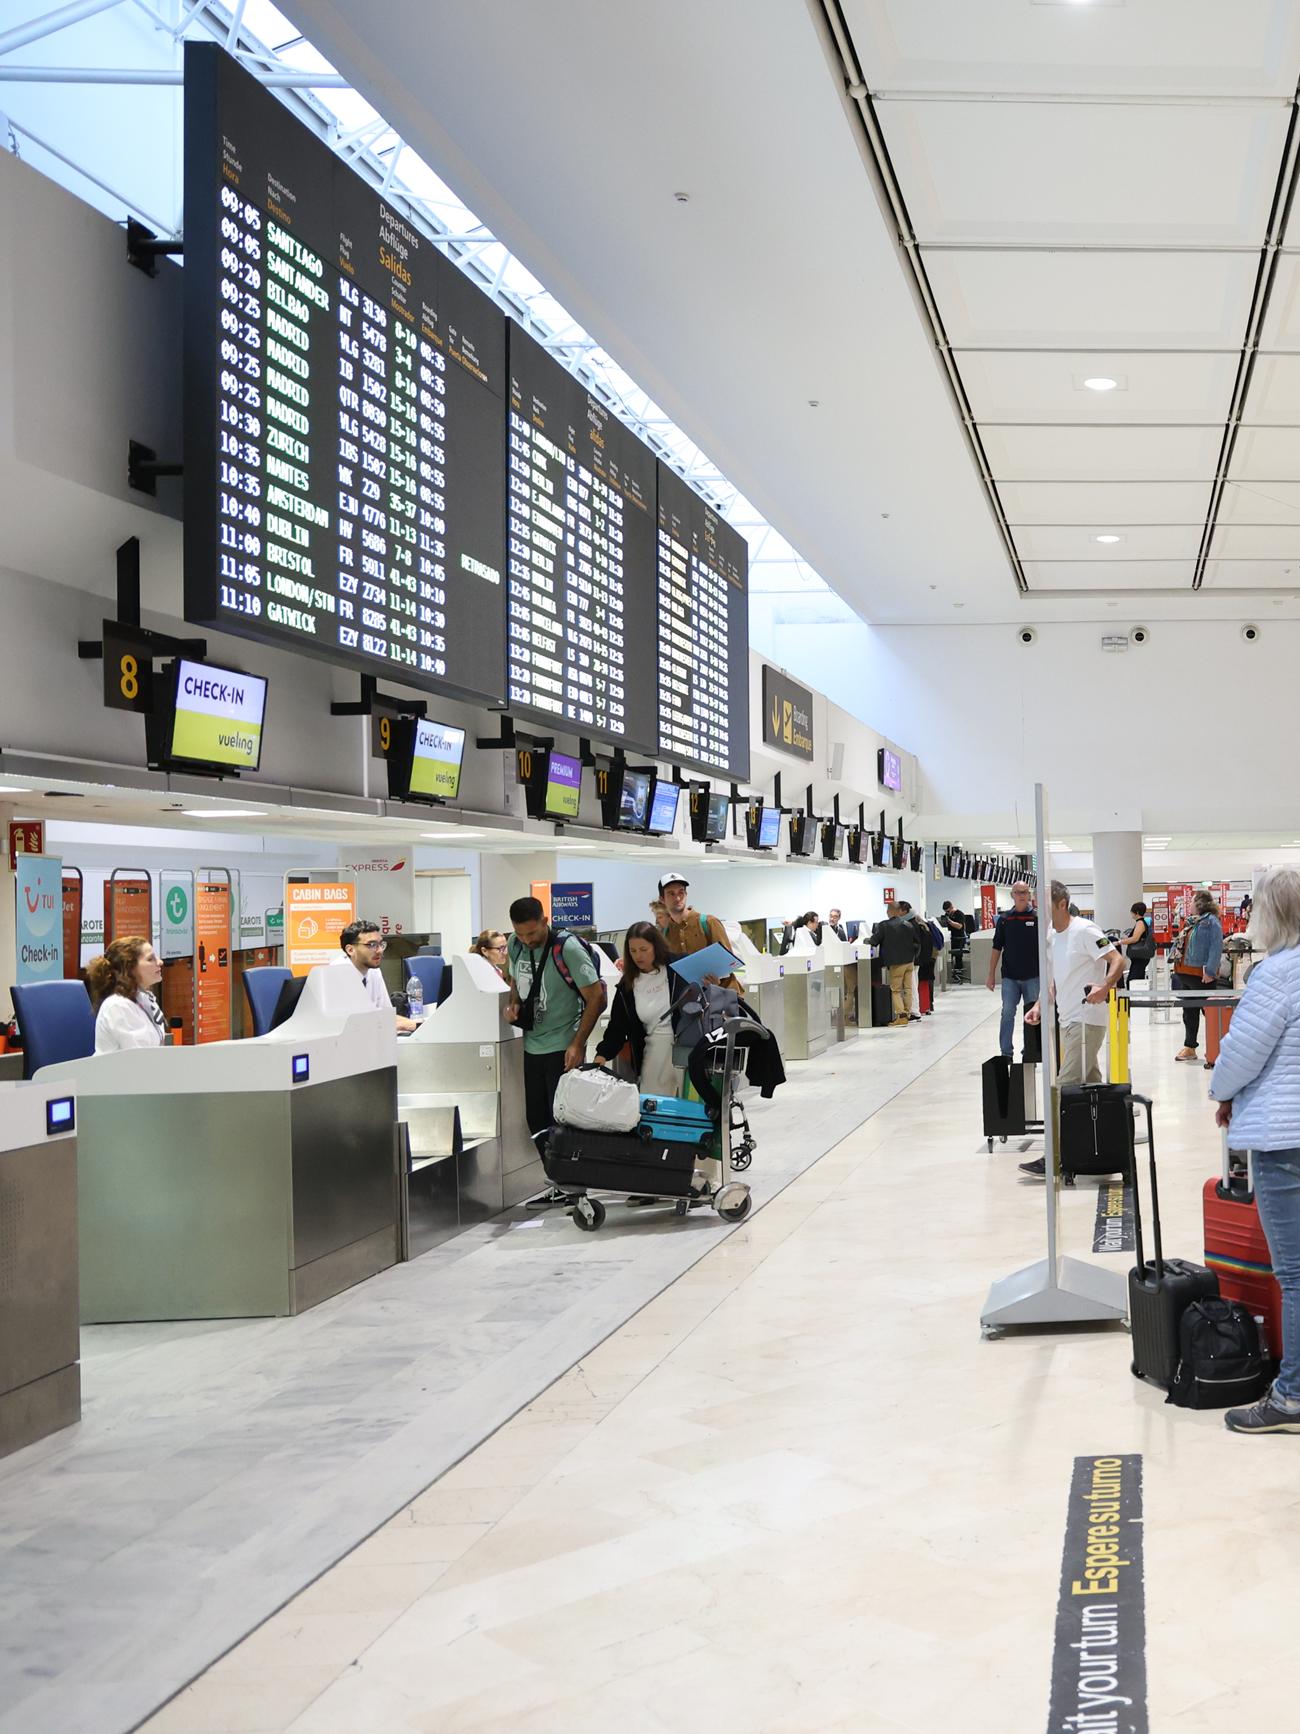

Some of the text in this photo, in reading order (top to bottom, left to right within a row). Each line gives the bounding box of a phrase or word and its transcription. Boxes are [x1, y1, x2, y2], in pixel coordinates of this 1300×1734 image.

[223, 136, 236, 153] Time
[223, 163, 240, 184] Hora
[379, 225, 408, 260] Abflüge
[380, 204, 419, 249] Departures
[221, 186, 261, 230] 09:05
[267, 221, 323, 278] SANTIAGO
[340, 278, 359, 306] VLG
[395, 321, 417, 350] 8-10
[420, 341, 445, 371] 08:35
[379, 246, 411, 286] Salidas
[221, 217, 261, 260] 09:05
[267, 250, 329, 311] SANTANDER
[395, 346, 412, 371] 3-4
[420, 365, 445, 395] 08:35
[221, 247, 261, 289] 09:20
[267, 279, 309, 323] BILBAO
[340, 331, 359, 359] VLG
[395, 371, 417, 398] 8-10
[420, 389, 445, 418] 08:50
[221, 278, 260, 319] 09:25
[267, 308, 309, 351] MADRID
[339, 357, 353, 381] IB
[390, 392, 417, 423] 15-16
[420, 413, 445, 441] 08:55
[221, 309, 260, 348] 09:25
[267, 337, 309, 379] MADRID
[339, 385, 359, 411] QTR
[390, 416, 417, 447] 15-16
[420, 437, 445, 464] 08:55
[221, 339, 260, 378] 09:25
[267, 366, 309, 407] MADRID
[339, 411, 358, 437] VLG
[390, 441, 417, 471] 15-16
[420, 461, 445, 488] 08:55
[221, 370, 260, 407] 09:25
[267, 395, 309, 435] MADRID
[339, 438, 358, 463] IBS
[390, 467, 417, 495] 15-16
[420, 485, 445, 511] 08:55
[221, 400, 260, 437] 10:30
[267, 425, 309, 463] ZURICH
[389, 492, 417, 519] 35-37
[420, 508, 445, 535] 10:00
[221, 431, 260, 467] 10:35
[267, 454, 309, 491] NANTES
[389, 517, 417, 544] 11-13
[420, 532, 445, 558] 11:35
[221, 461, 260, 496] 10:35
[267, 484, 329, 528] AMSTERDAM
[395, 544, 412, 566] 7-8
[420, 556, 445, 582] 10:05
[221, 492, 260, 526] 10:40
[267, 512, 309, 547] DUBLIN
[339, 545, 354, 567] FR
[390, 568, 417, 593] 41-43
[420, 581, 445, 605] 10:10
[221, 523, 260, 556] 11:00
[267, 542, 315, 578] BRISTOL
[339, 572, 359, 594] EZY
[390, 592, 417, 617] 11-14
[420, 605, 445, 629] 10:30
[221, 554, 260, 586] 11:05
[267, 571, 335, 613] LONDON/STN
[339, 599, 354, 620] FR
[390, 618, 417, 642] 41-43
[420, 629, 446, 652] 10:35
[221, 585, 261, 616] 11:10
[267, 602, 316, 634] GATWICK
[340, 626, 359, 647] EZY
[390, 643, 417, 666] 11-14
[420, 653, 445, 675] 10:40
[120, 655, 139, 699] 8
[184, 676, 245, 706] CHECK-IN
[380, 717, 391, 751] 9
[794, 705, 808, 731] Boarding
[218, 732, 253, 757] vueling
[419, 731, 452, 752] CHECK-IN
[793, 729, 812, 752] Embarque
[435, 770, 456, 788] vueling
[519, 751, 531, 778] 10
[551, 762, 573, 779] PREMIUM
[599, 770, 608, 794] 11
[691, 793, 698, 813] 12
[42, 895, 54, 909] TUI
[293, 889, 348, 900] CABIN BAGS
[22, 944, 58, 963] Check-in
[1072, 1458, 1130, 1595] Espere su turno
[1070, 1604, 1118, 1649] turn
[1077, 1651, 1132, 1709] your
